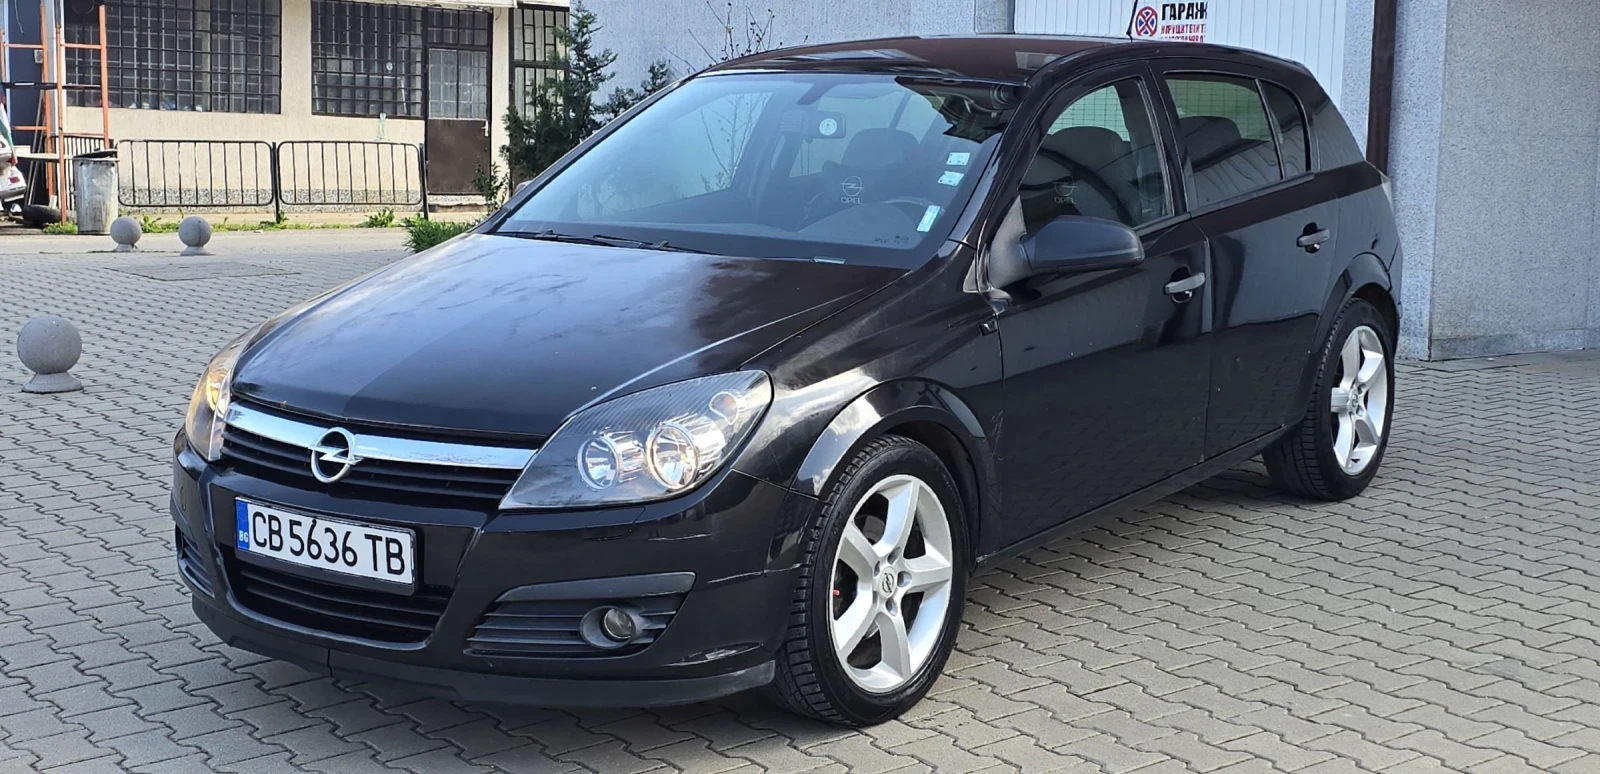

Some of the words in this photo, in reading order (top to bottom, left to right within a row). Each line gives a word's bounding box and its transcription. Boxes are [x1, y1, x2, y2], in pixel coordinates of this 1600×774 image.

[1162, 2, 1208, 20] ГАРАЖ
[840, 196, 863, 205] OPEL
[239, 530, 249, 542] BG
[252, 511, 284, 552] CB
[289, 518, 358, 567] 5636
[364, 533, 405, 575] TB
